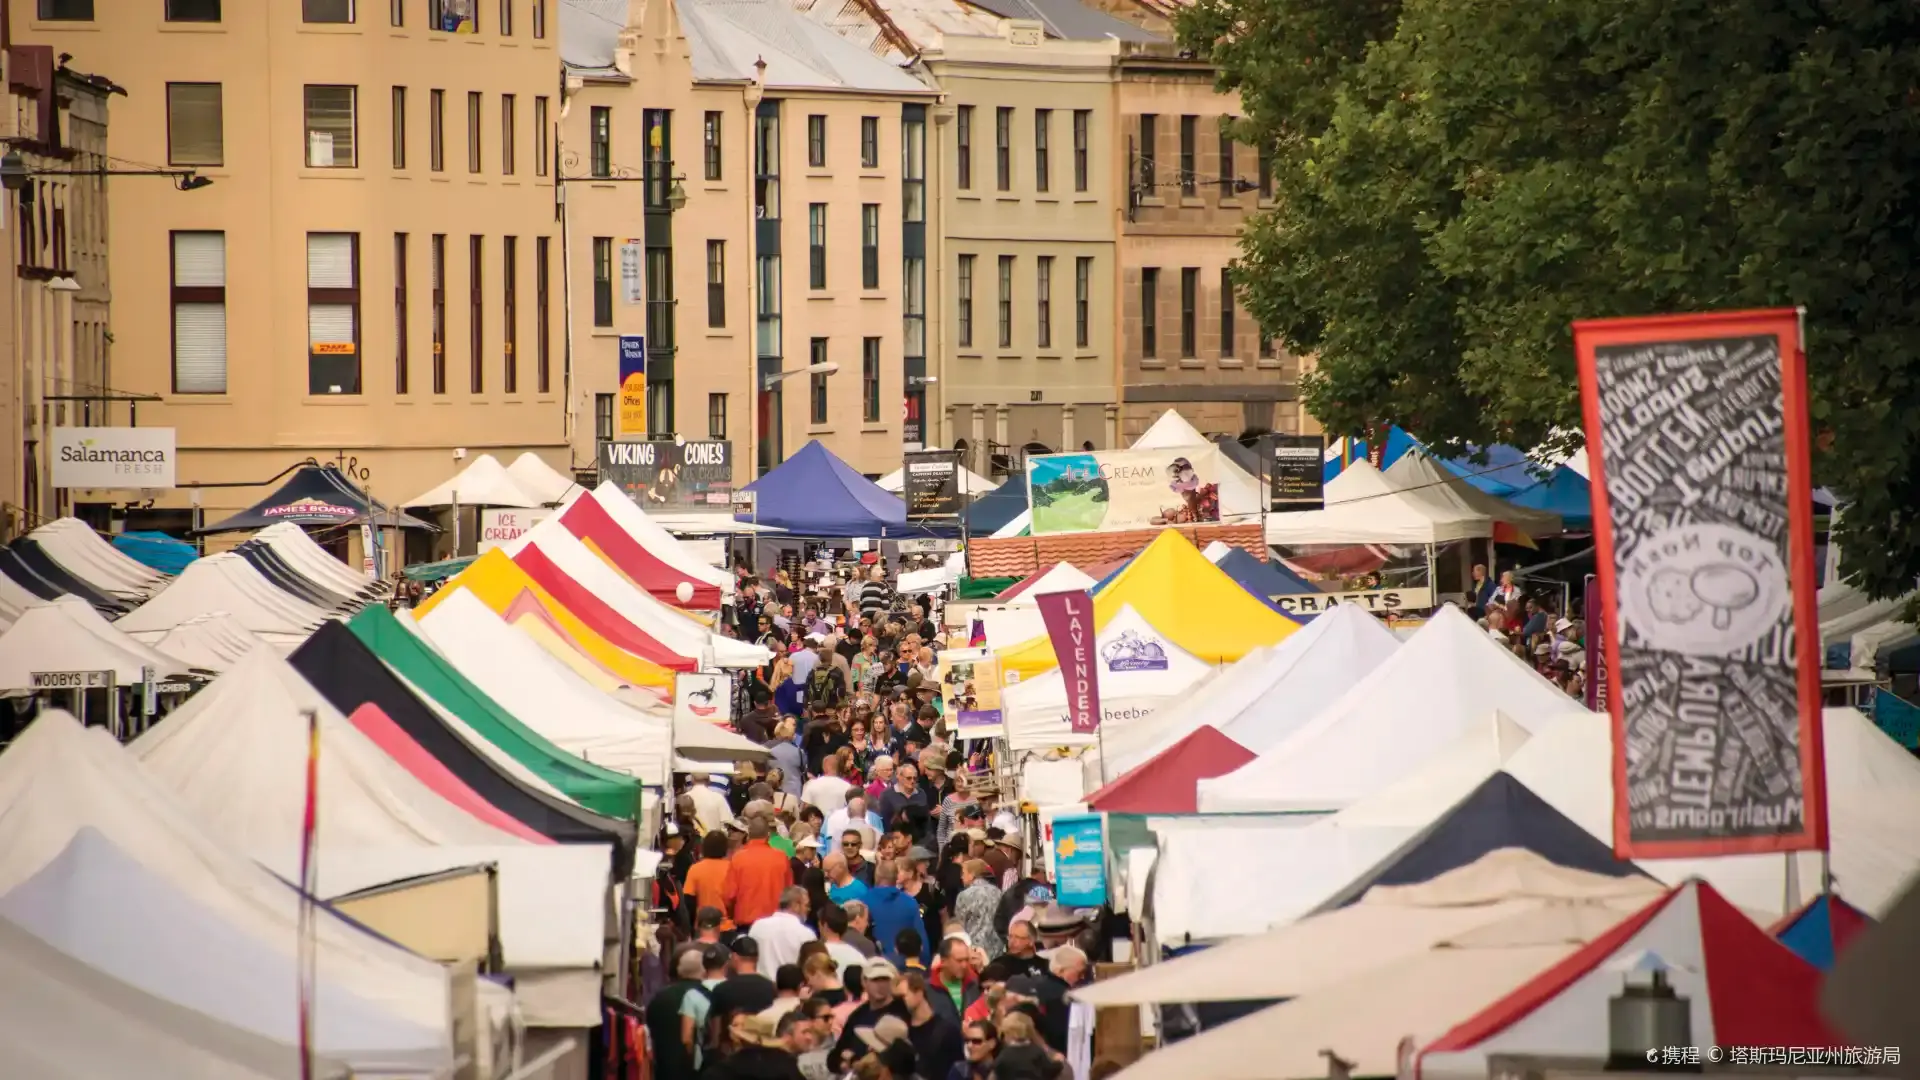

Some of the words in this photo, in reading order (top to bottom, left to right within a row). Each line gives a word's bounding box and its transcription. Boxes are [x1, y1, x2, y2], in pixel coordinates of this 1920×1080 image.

[61, 444, 164, 462] Salamanca
[608, 444, 655, 464] VIKING
[684, 443, 724, 464] CONES
[115, 464, 162, 474] FRESH
[1098, 462, 1155, 481] CREAM
[263, 505, 307, 516] JAMES
[498, 514, 516, 526] ICE
[1276, 593, 1402, 612] CRATS
[1064, 597, 1090, 725] LAVENDER
[33, 673, 81, 686] WOOBYS
